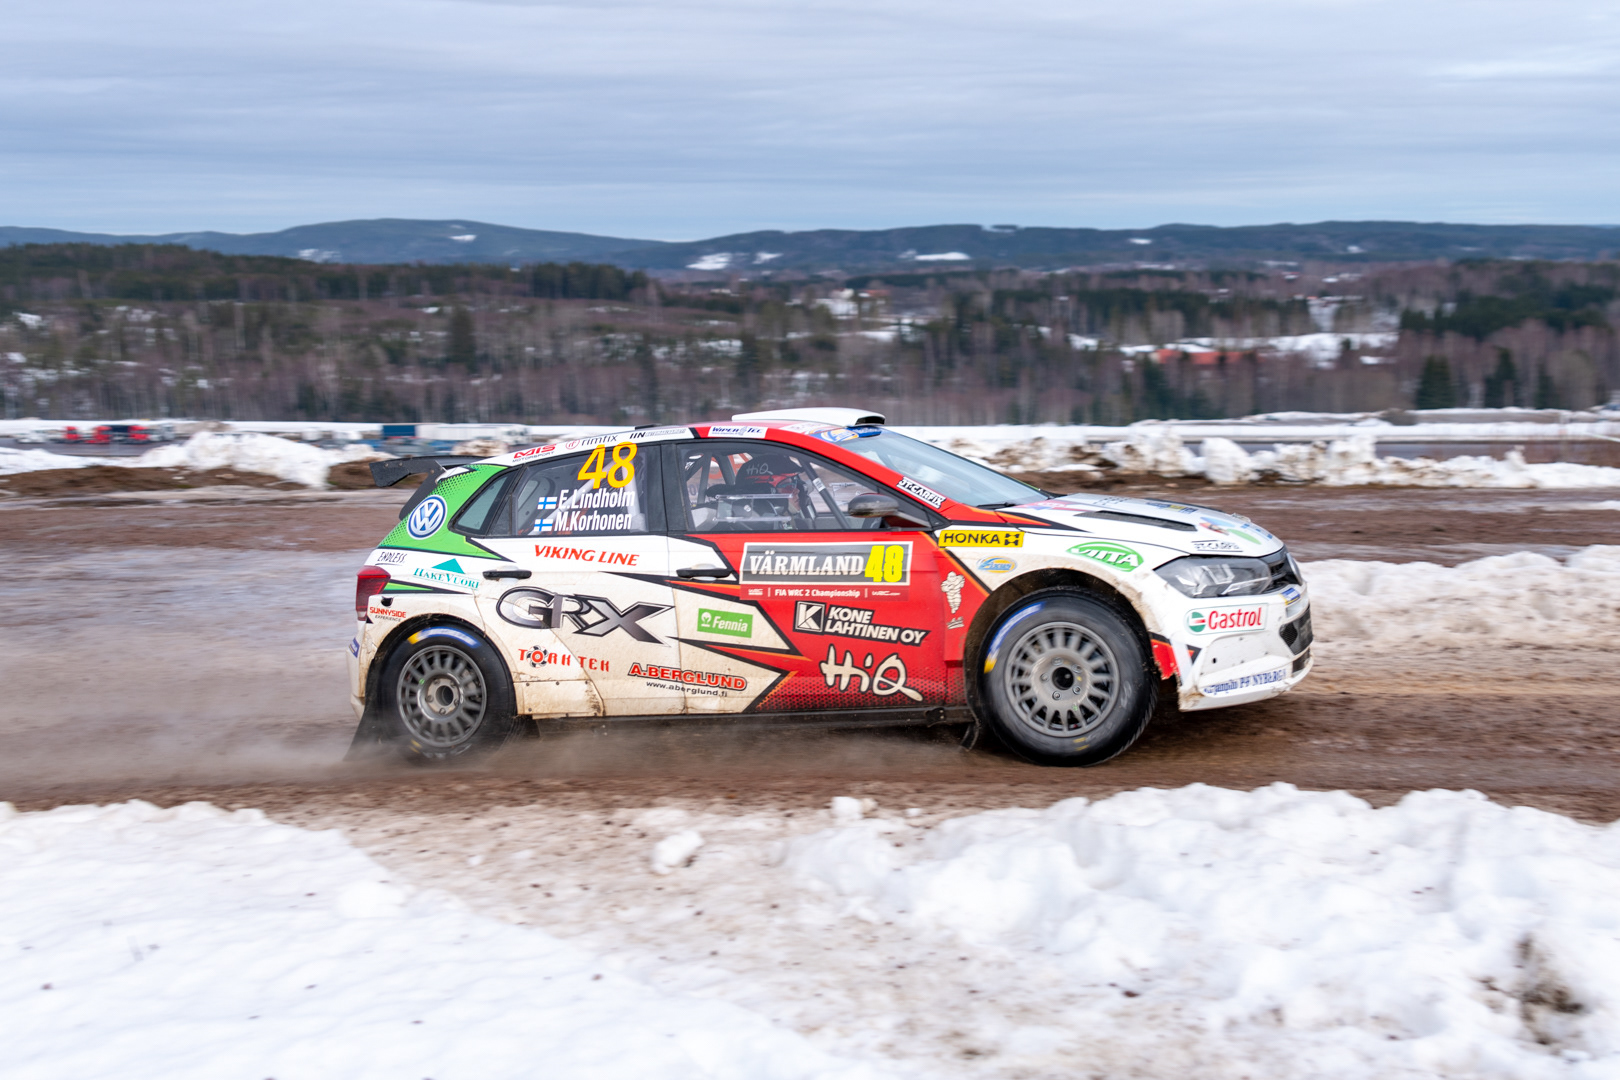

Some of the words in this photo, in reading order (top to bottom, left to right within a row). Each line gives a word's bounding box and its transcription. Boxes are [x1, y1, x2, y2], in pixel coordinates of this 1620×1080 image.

[581, 435, 618, 446] rimfix
[513, 443, 557, 459] MIS
[577, 441, 638, 489] 48
[557, 489, 636, 510] E.Lindholm
[554, 511, 633, 532] M.Korhonen
[943, 532, 1001, 545] HONKA
[376, 551, 408, 564] ENDLESS
[534, 544, 596, 562] VIKING
[597, 551, 640, 567] LINE
[749, 550, 865, 576] VÄRMLAND
[864, 545, 905, 583] 48
[774, 587, 787, 597] FIA
[787, 588, 804, 597] WRC
[805, 588, 811, 597] 2
[811, 588, 861, 598] Championship
[369, 606, 407, 619] SUNNYSIDE
[374, 614, 402, 623] EXPERIENCE
[496, 586, 675, 648] GRX
[828, 606, 873, 624] KONE
[1208, 607, 1263, 630] Castrol
[712, 616, 749, 633] Fennia
[825, 620, 900, 642] LAHTINEN
[900, 629, 926, 645] OY
[628, 663, 747, 691] A.BERGLUND
[819, 643, 924, 702] HiQ
[646, 681, 728, 698] www.aberglund.fi
